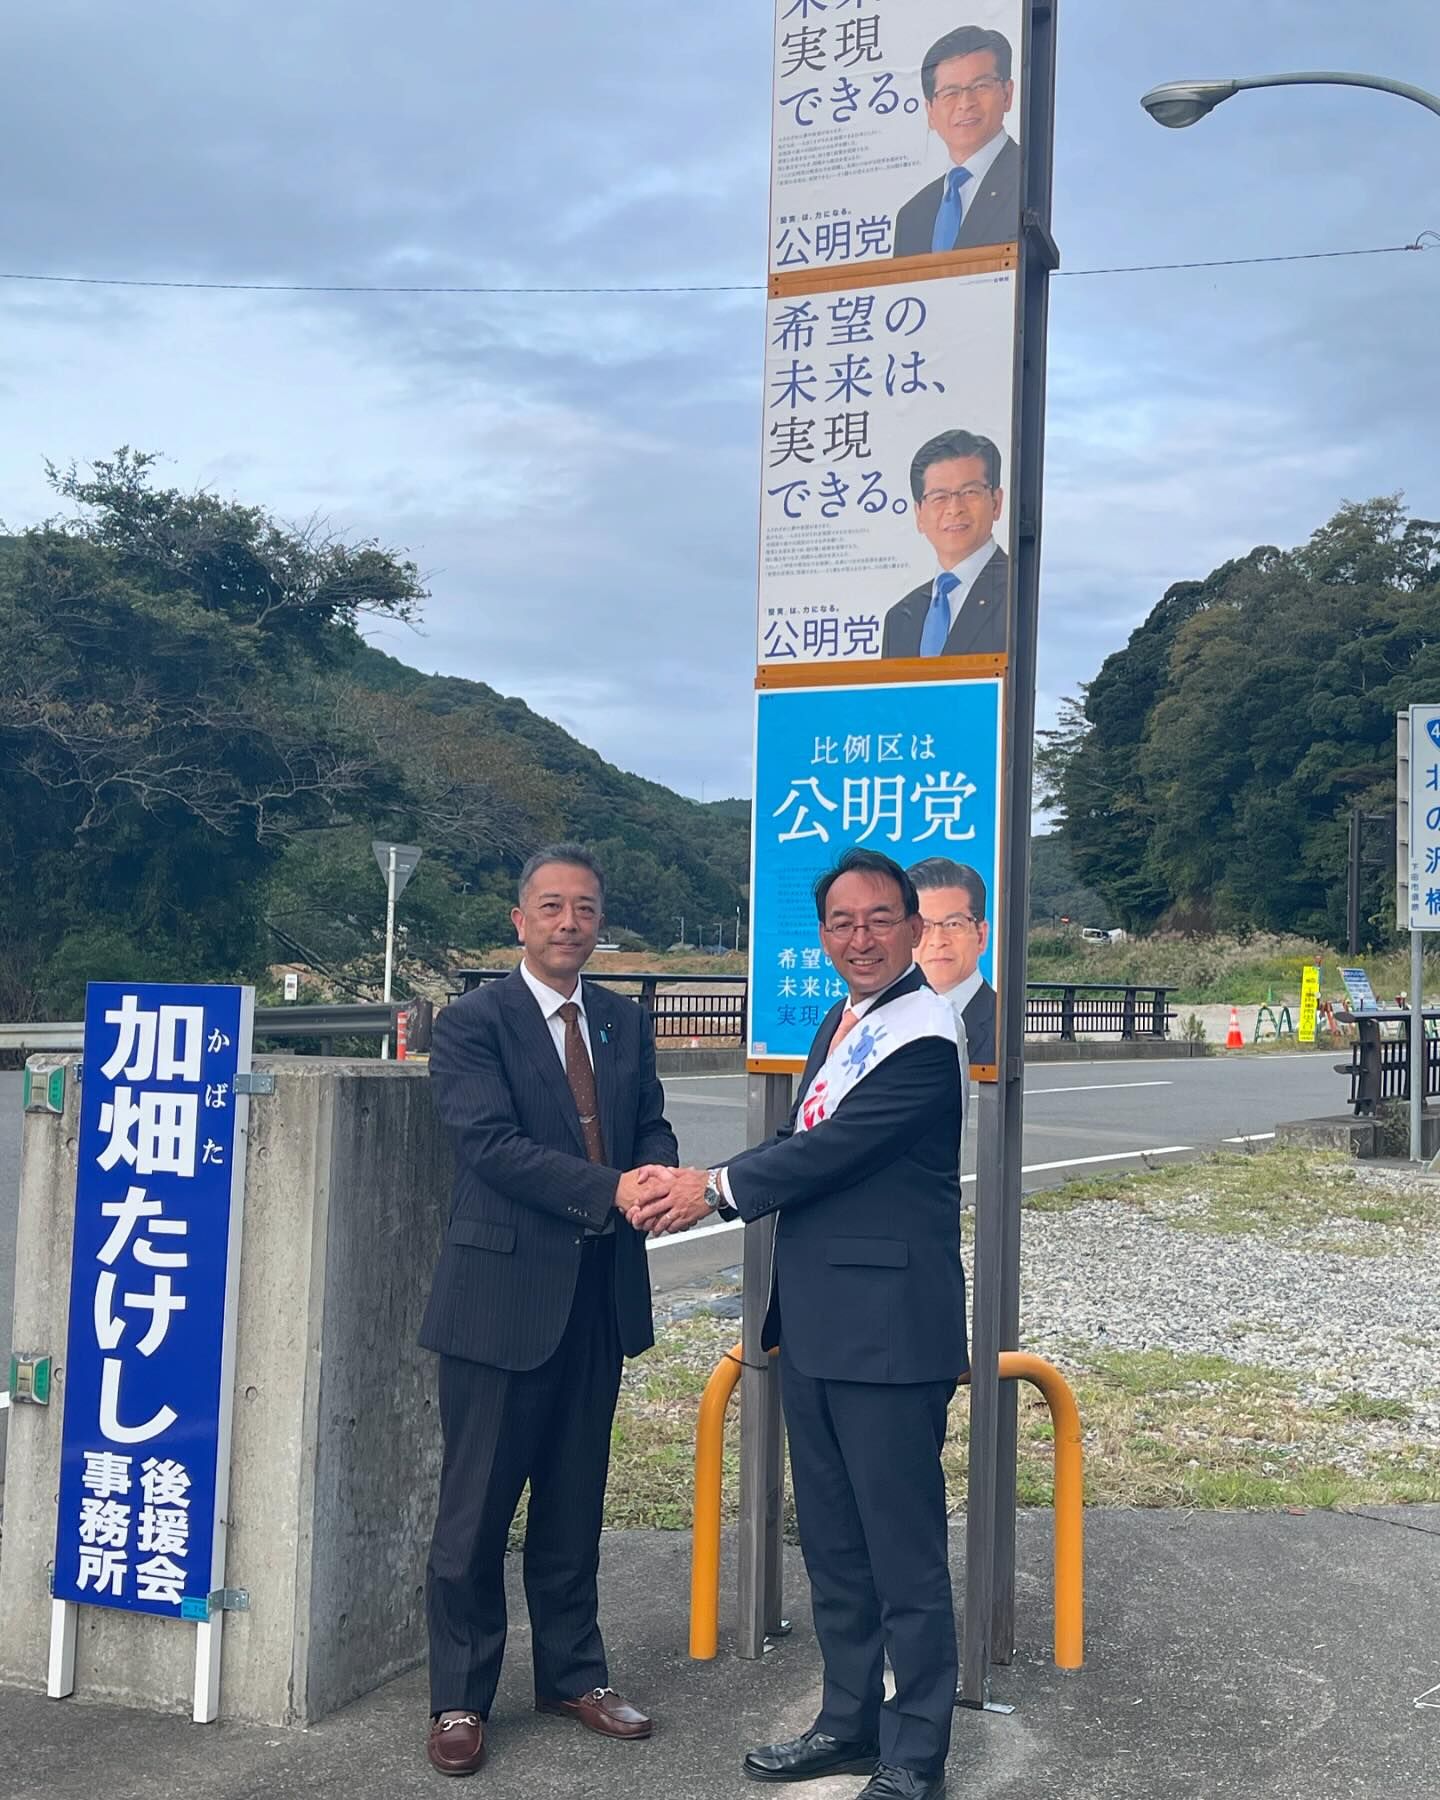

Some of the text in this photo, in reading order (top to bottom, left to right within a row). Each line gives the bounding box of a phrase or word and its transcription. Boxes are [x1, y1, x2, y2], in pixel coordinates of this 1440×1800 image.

[780, 14, 883, 79] 実現
[778, 72, 920, 127] できる。
[775, 214, 892, 267] 公明党
[771, 294, 927, 352] 希望の
[769, 351, 946, 409] 未来は、
[768, 410, 873, 468] 実現
[766, 470, 909, 519] できる。
[763, 614, 880, 659] 公明党
[810, 732, 936, 766] 比例区は
[772, 770, 977, 844] 公明党
[776, 1003, 830, 1027] 実現
[202, 1028, 231, 1165] かばた
[94, 994, 205, 1445] 加畑たけし
[75, 1450, 134, 1596] 事務所
[135, 1455, 192, 1606] 後援会
